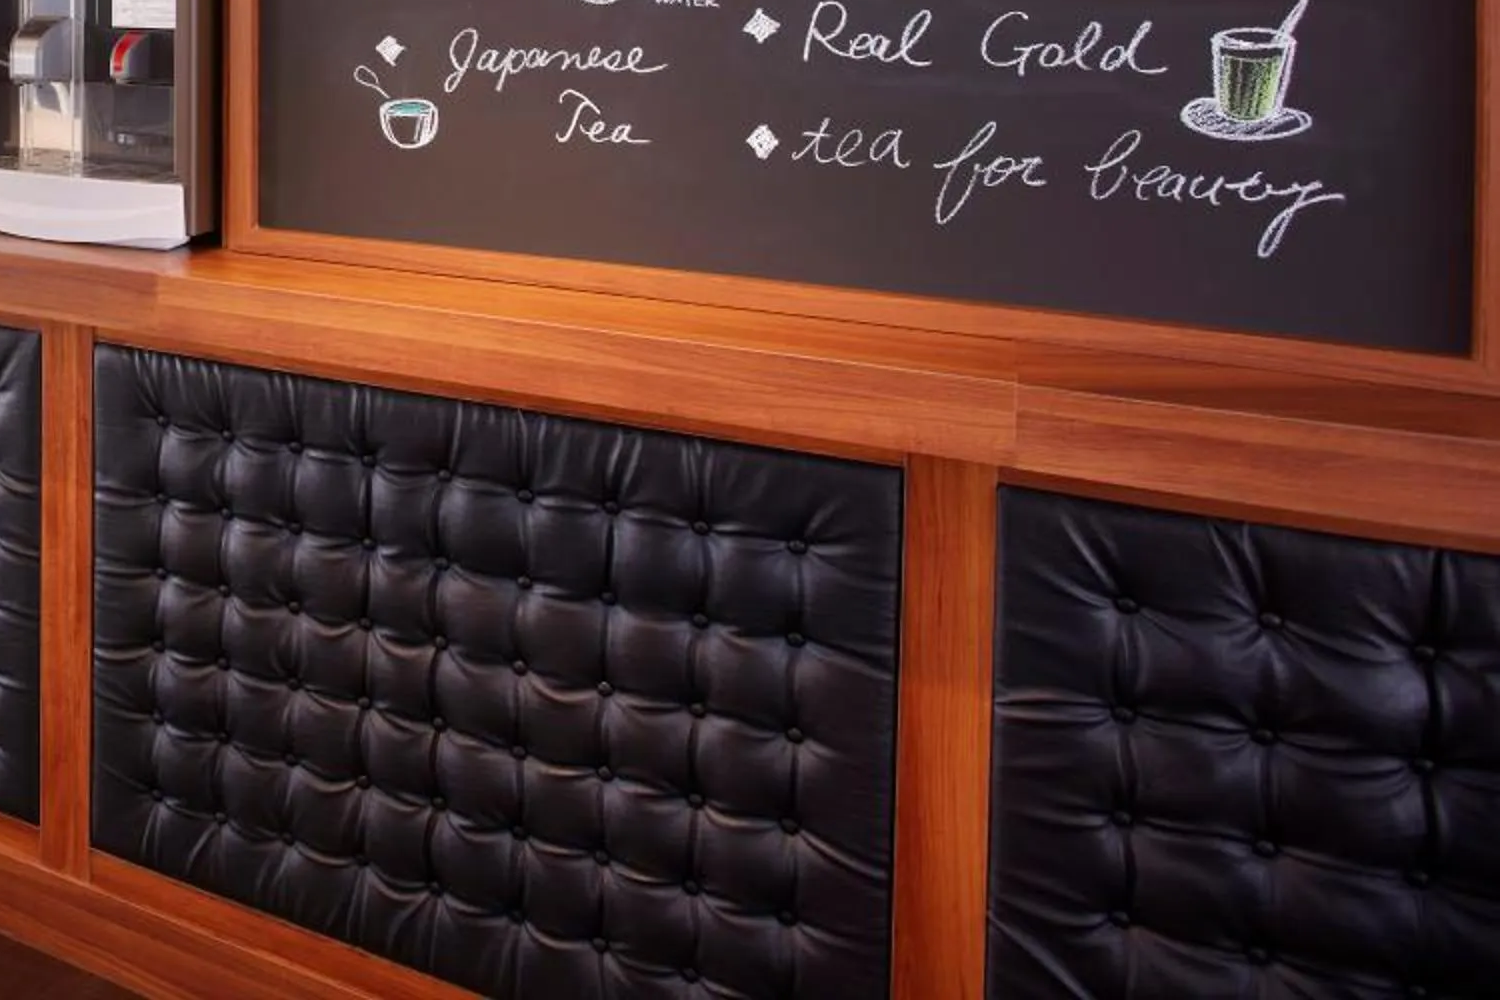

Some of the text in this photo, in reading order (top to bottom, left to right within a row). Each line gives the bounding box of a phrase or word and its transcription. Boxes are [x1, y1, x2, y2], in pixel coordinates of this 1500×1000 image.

[444, 28, 668, 93] Japanese
[803, 1, 1167, 76] Real Gold
[556, 89, 652, 144] Tea
[792, 118, 1345, 258] tea for beauty
